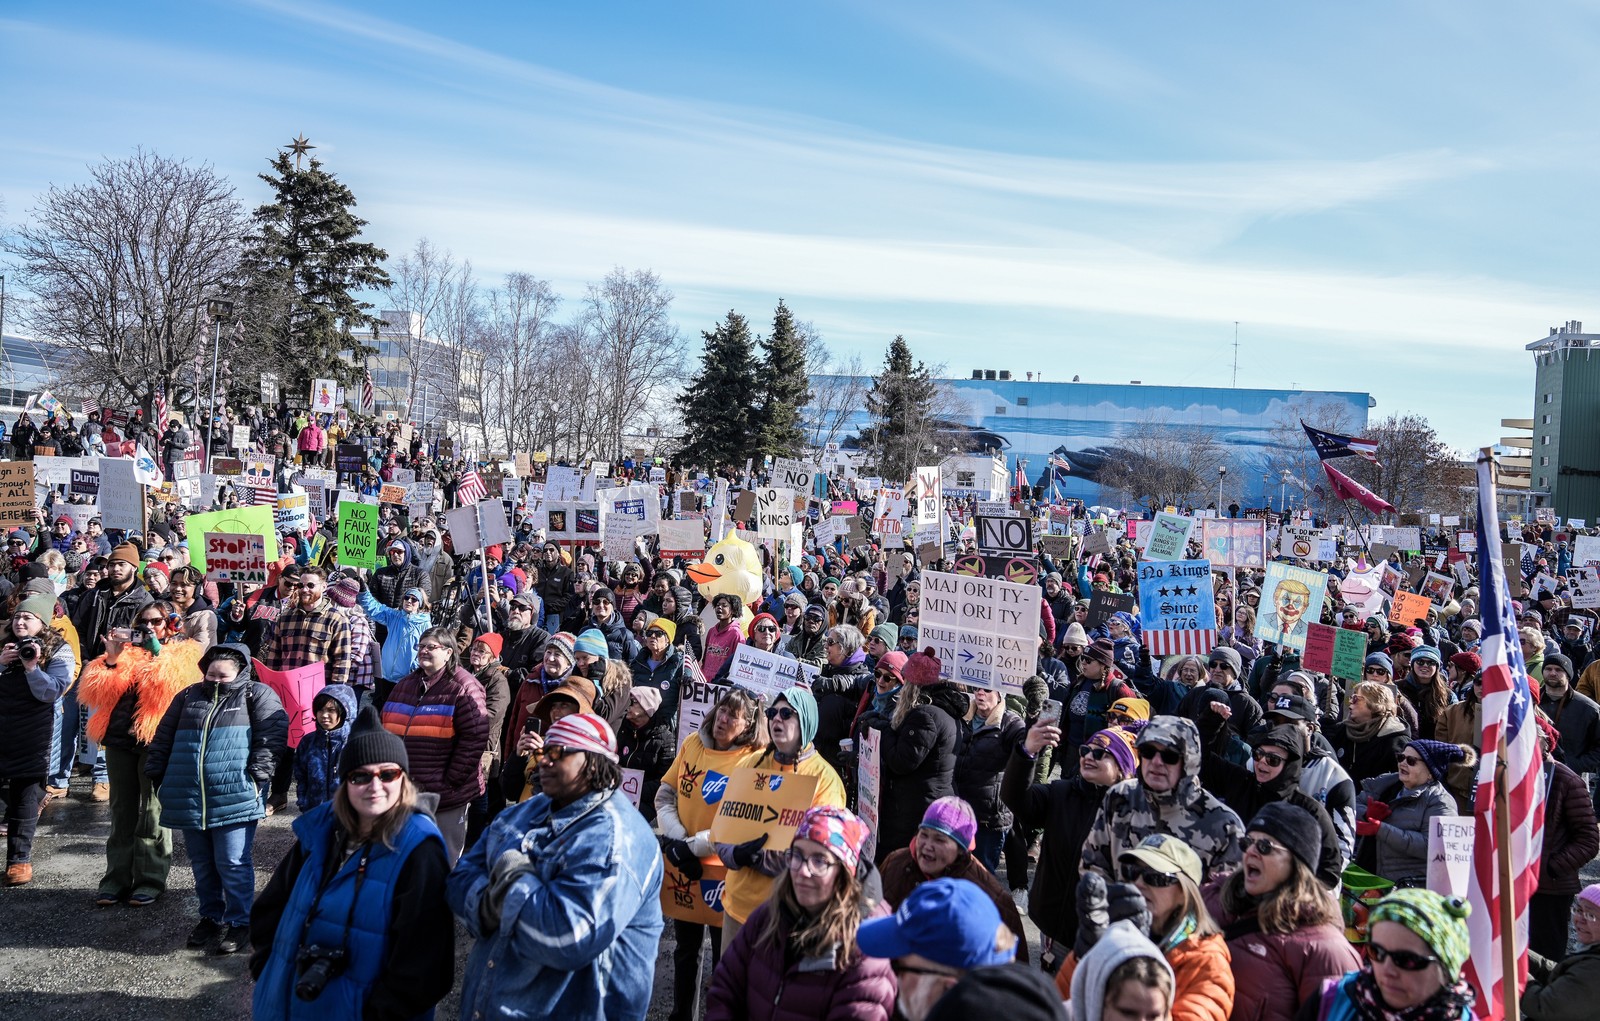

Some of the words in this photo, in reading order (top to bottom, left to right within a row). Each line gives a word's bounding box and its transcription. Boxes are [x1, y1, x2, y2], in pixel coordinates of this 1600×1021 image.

[17, 466, 27, 475] is
[248, 476, 272, 487] SUCK
[784, 470, 809, 487] NO
[7, 489, 29, 498] ALL
[758, 489, 777, 510] NO
[2, 500, 33, 508] reasons
[277, 495, 307, 510] OVE
[925, 499, 936, 512] NO
[351, 509, 367, 519] NO
[760, 512, 790, 526] KINGS
[344, 519, 375, 535] FAUX-
[982, 518, 1026, 549] NO
[343, 532, 371, 547] KING
[345, 547, 367, 559] WAY
[206, 557, 266, 573] genocide
[1169, 564, 1210, 578] Kings
[219, 570, 227, 578] in
[230, 571, 266, 582] IRAN
[1160, 602, 1199, 615] Since
[1393, 602, 1403, 611] NO
[1164, 618, 1198, 630] 1776
[923, 627, 956, 643] RULE
[939, 647, 954, 660] IN
[739, 653, 752, 661] WE
[752, 657, 774, 669] NEED
[739, 664, 755, 674] NOT
[960, 666, 992, 681] VOTE!
[1276, 696, 1291, 709] LA
[680, 780, 693, 792] NO
[702, 775, 729, 799] aft
[769, 775, 784, 790] aft
[719, 800, 764, 822] FREEDOM
[1446, 842, 1459, 851] THE
[1432, 854, 1452, 863] AND
[674, 890, 693, 905] NO
